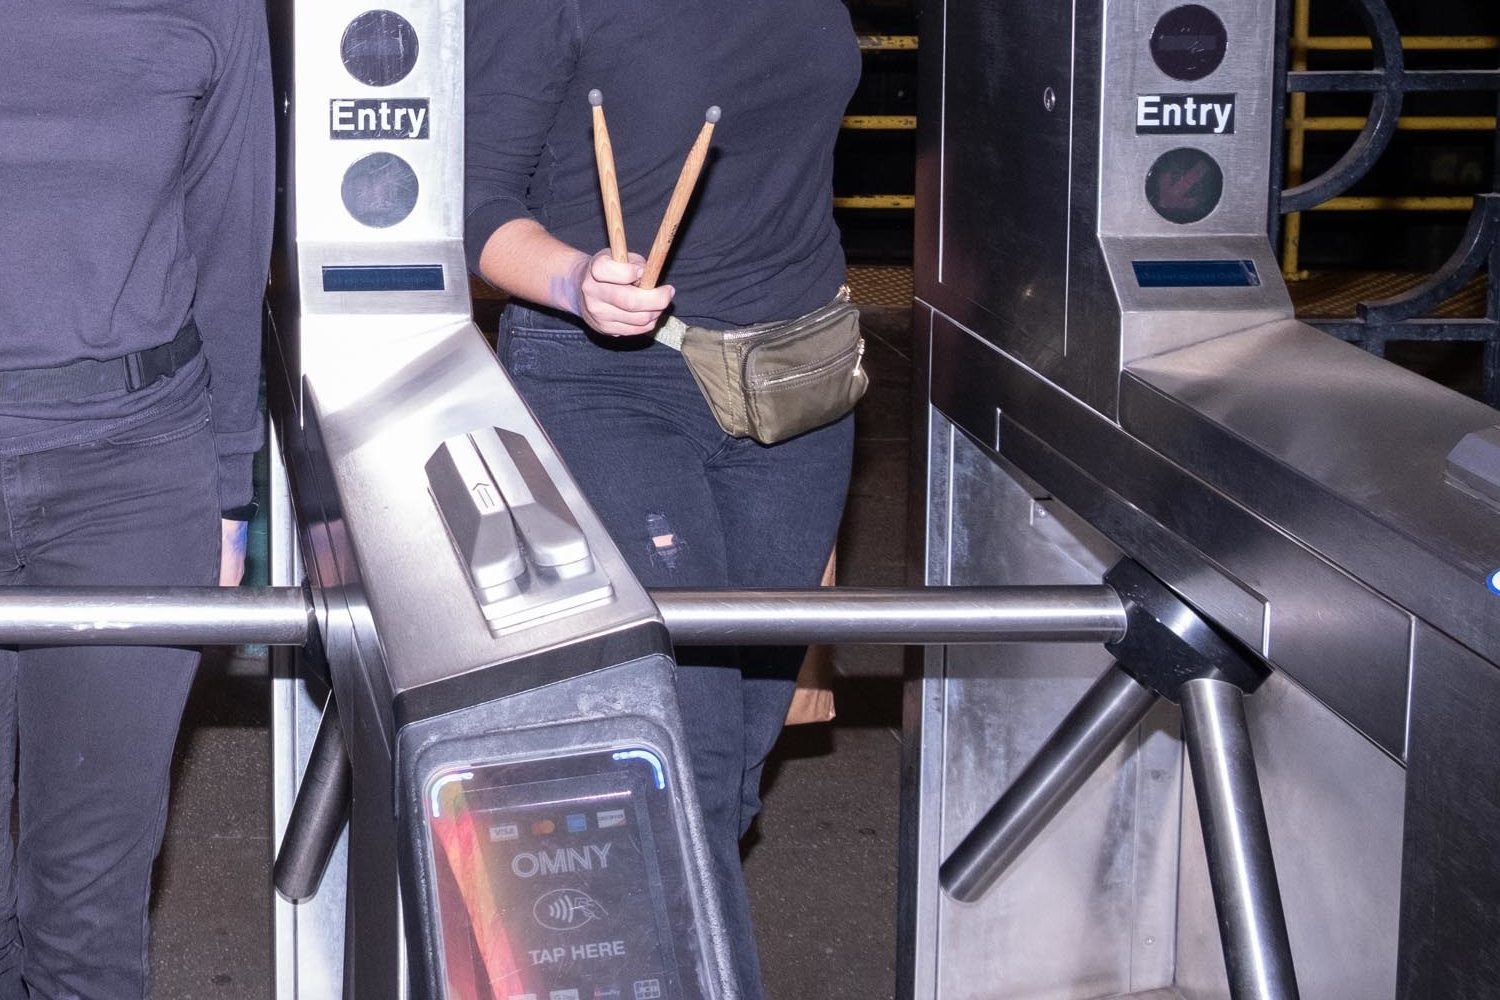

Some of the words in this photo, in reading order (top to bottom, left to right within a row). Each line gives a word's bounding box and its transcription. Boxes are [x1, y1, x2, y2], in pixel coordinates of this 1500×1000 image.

[332, 101, 426, 138] Entry
[1137, 95, 1232, 133] Entry
[512, 842, 612, 878] OMNY
[529, 947, 565, 965] TAP
[572, 940, 626, 960] HERE
